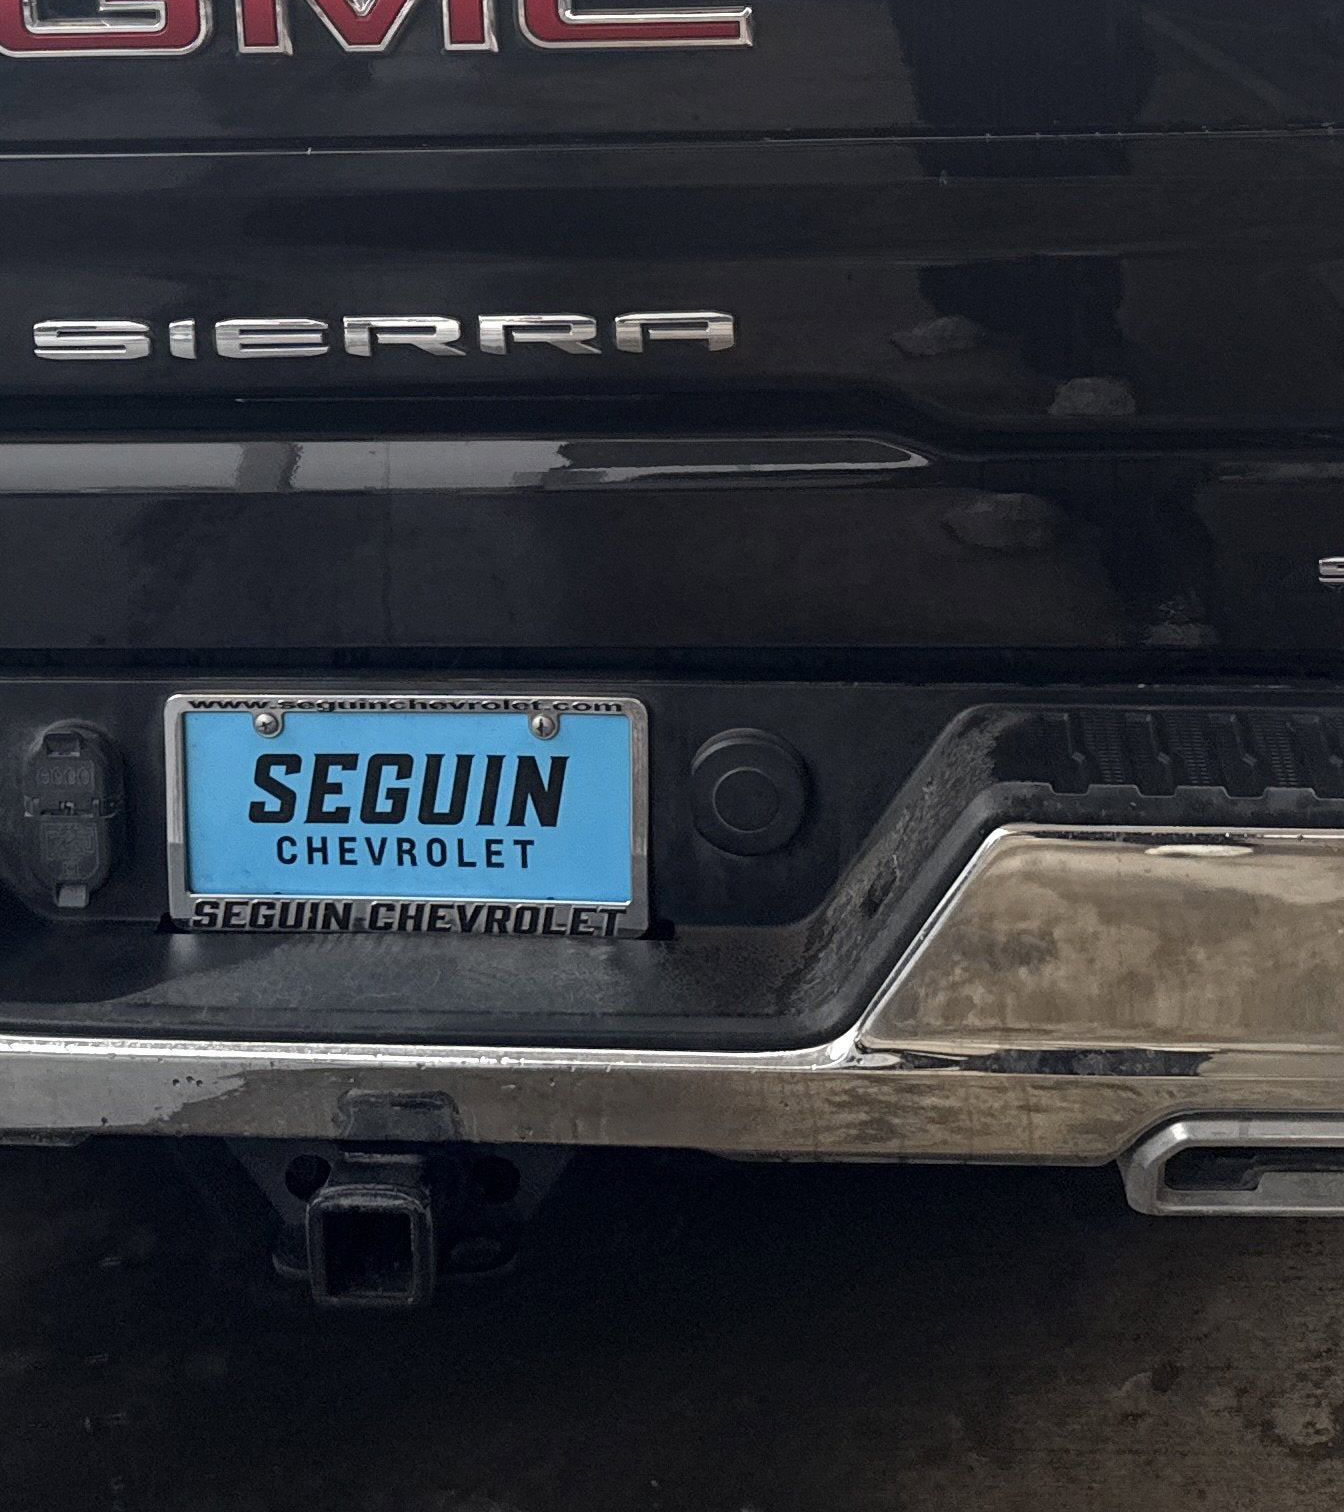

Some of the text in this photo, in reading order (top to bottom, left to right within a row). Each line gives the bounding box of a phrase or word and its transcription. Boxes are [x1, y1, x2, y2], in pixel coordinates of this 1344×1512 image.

[33, 310, 735, 359] SIERRA
[187, 698, 623, 713] www.seguinchevrolet.com
[247, 753, 570, 827] SEGUIN
[275, 835, 535, 868] CHEVROLET
[192, 899, 628, 937] SEGUIN CHEVROLET
